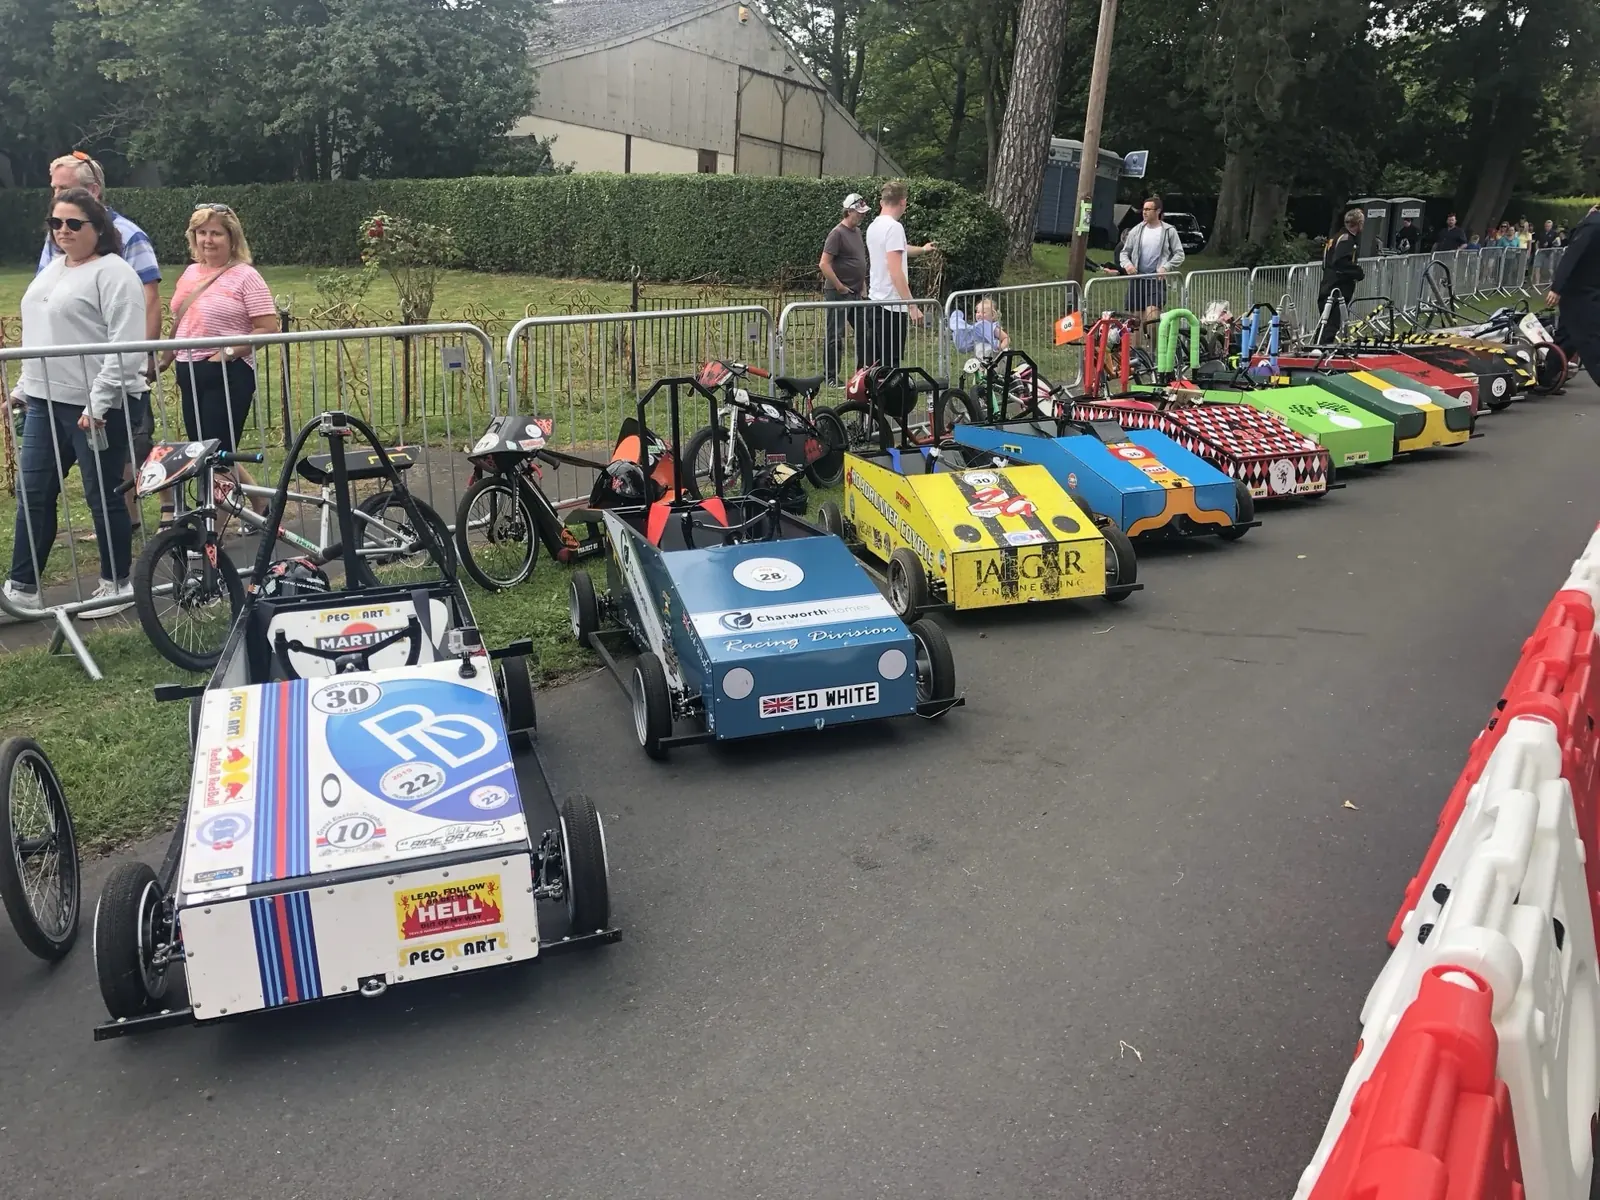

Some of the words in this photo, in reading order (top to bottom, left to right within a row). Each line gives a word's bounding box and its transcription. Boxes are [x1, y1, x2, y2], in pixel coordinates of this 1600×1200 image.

[851, 469, 899, 531] ROADRUNNER
[900, 518, 934, 568] COYOTE
[760, 572, 782, 581] 28
[320, 630, 400, 650] MARTIN
[724, 637, 800, 653] Racing
[808, 626, 898, 642] Division
[326, 686, 369, 708] 30
[796, 692, 818, 710] ED
[826, 685, 876, 706] WHITE
[398, 774, 438, 796] 22
[481, 792, 502, 806] 22
[334, 822, 369, 844] 10
[444, 882, 486, 895] FOLLOW
[418, 898, 482, 923] HELL
[420, 922, 436, 930] OUT
